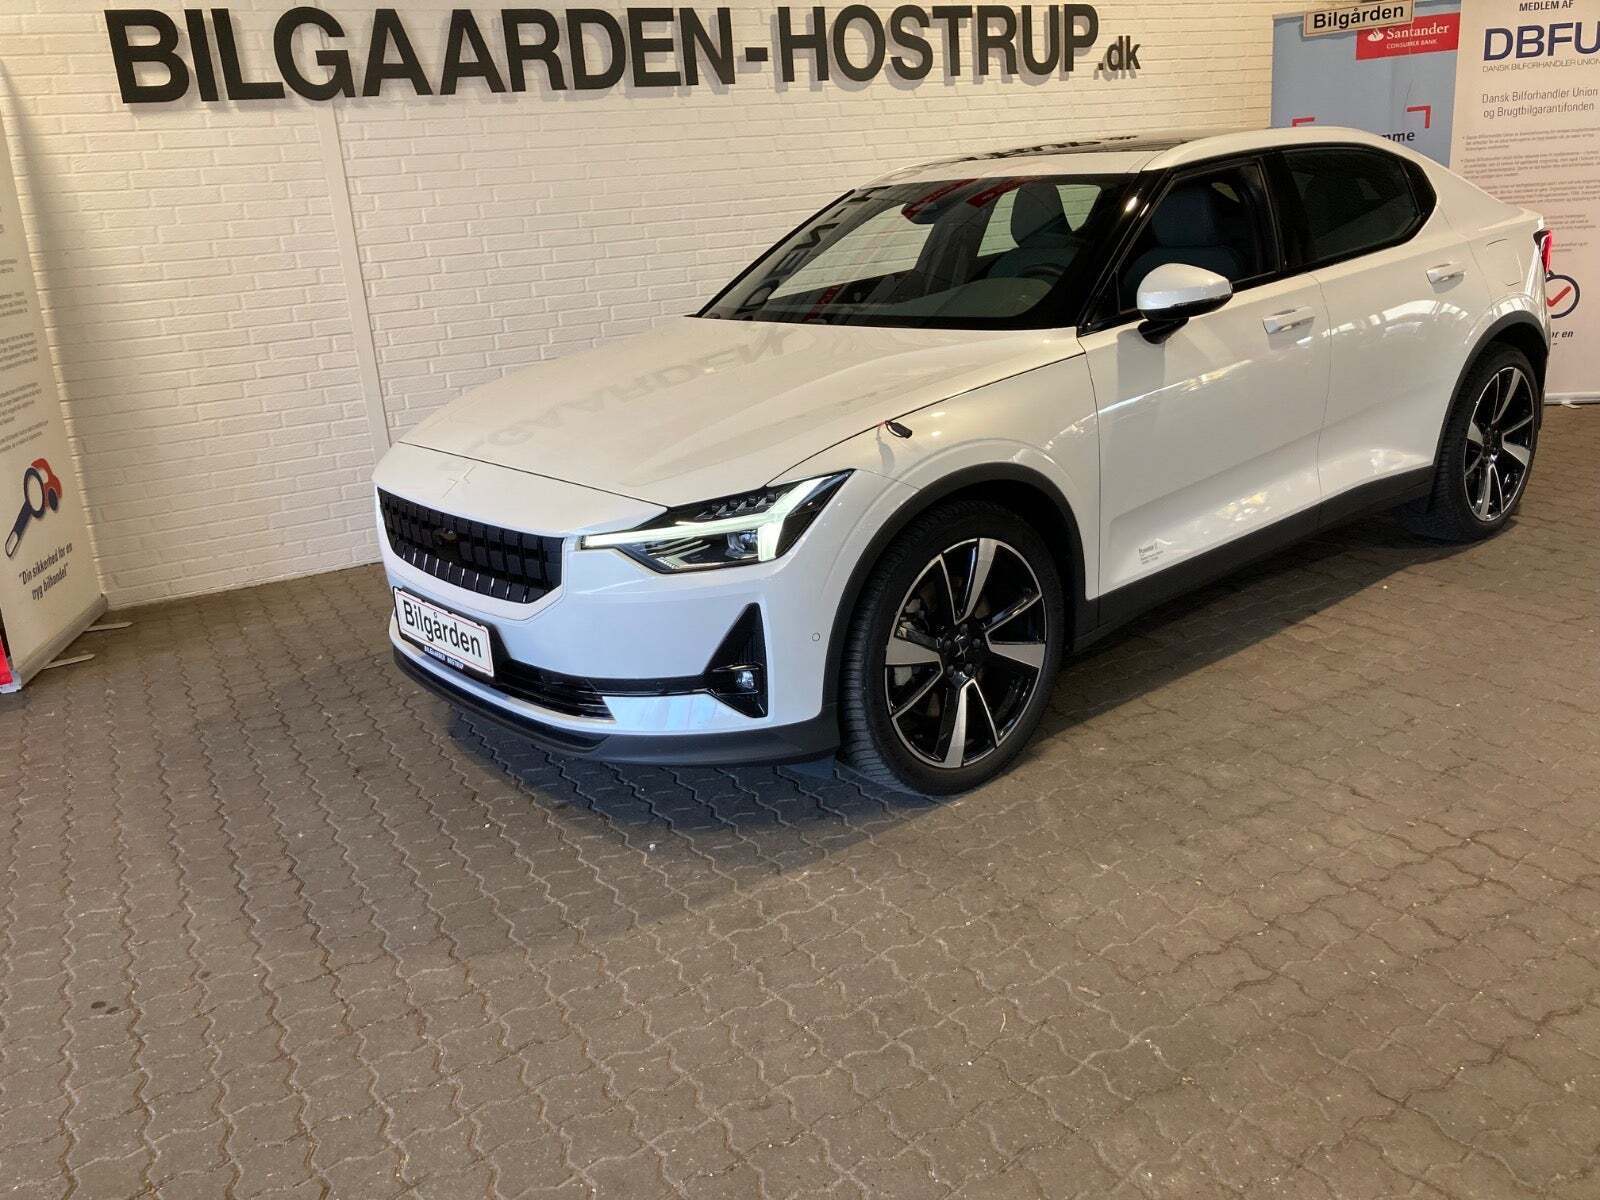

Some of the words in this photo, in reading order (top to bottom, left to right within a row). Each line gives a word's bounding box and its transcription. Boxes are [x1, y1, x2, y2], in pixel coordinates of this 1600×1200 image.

[1519, 1, 1559, 11] MEDLEM
[1562, 0, 1574, 8] AF
[1313, 6, 1405, 29] Bilgården
[1386, 22, 1450, 40] Santander
[1386, 40, 1419, 49] CONSUMER
[1483, 21, 1600, 61] DBFU
[1482, 64, 1511, 72] DANSK
[1511, 59, 1576, 71] BILFORHANDLER
[1482, 92, 1510, 104] Dansk
[1512, 89, 1570, 102] Bilforhandler
[1572, 87, 1598, 97] Union
[1483, 110, 1495, 119] og
[1497, 102, 1595, 118] Brugtbilgarantifonden
[403, 600, 482, 658] Bilgården
